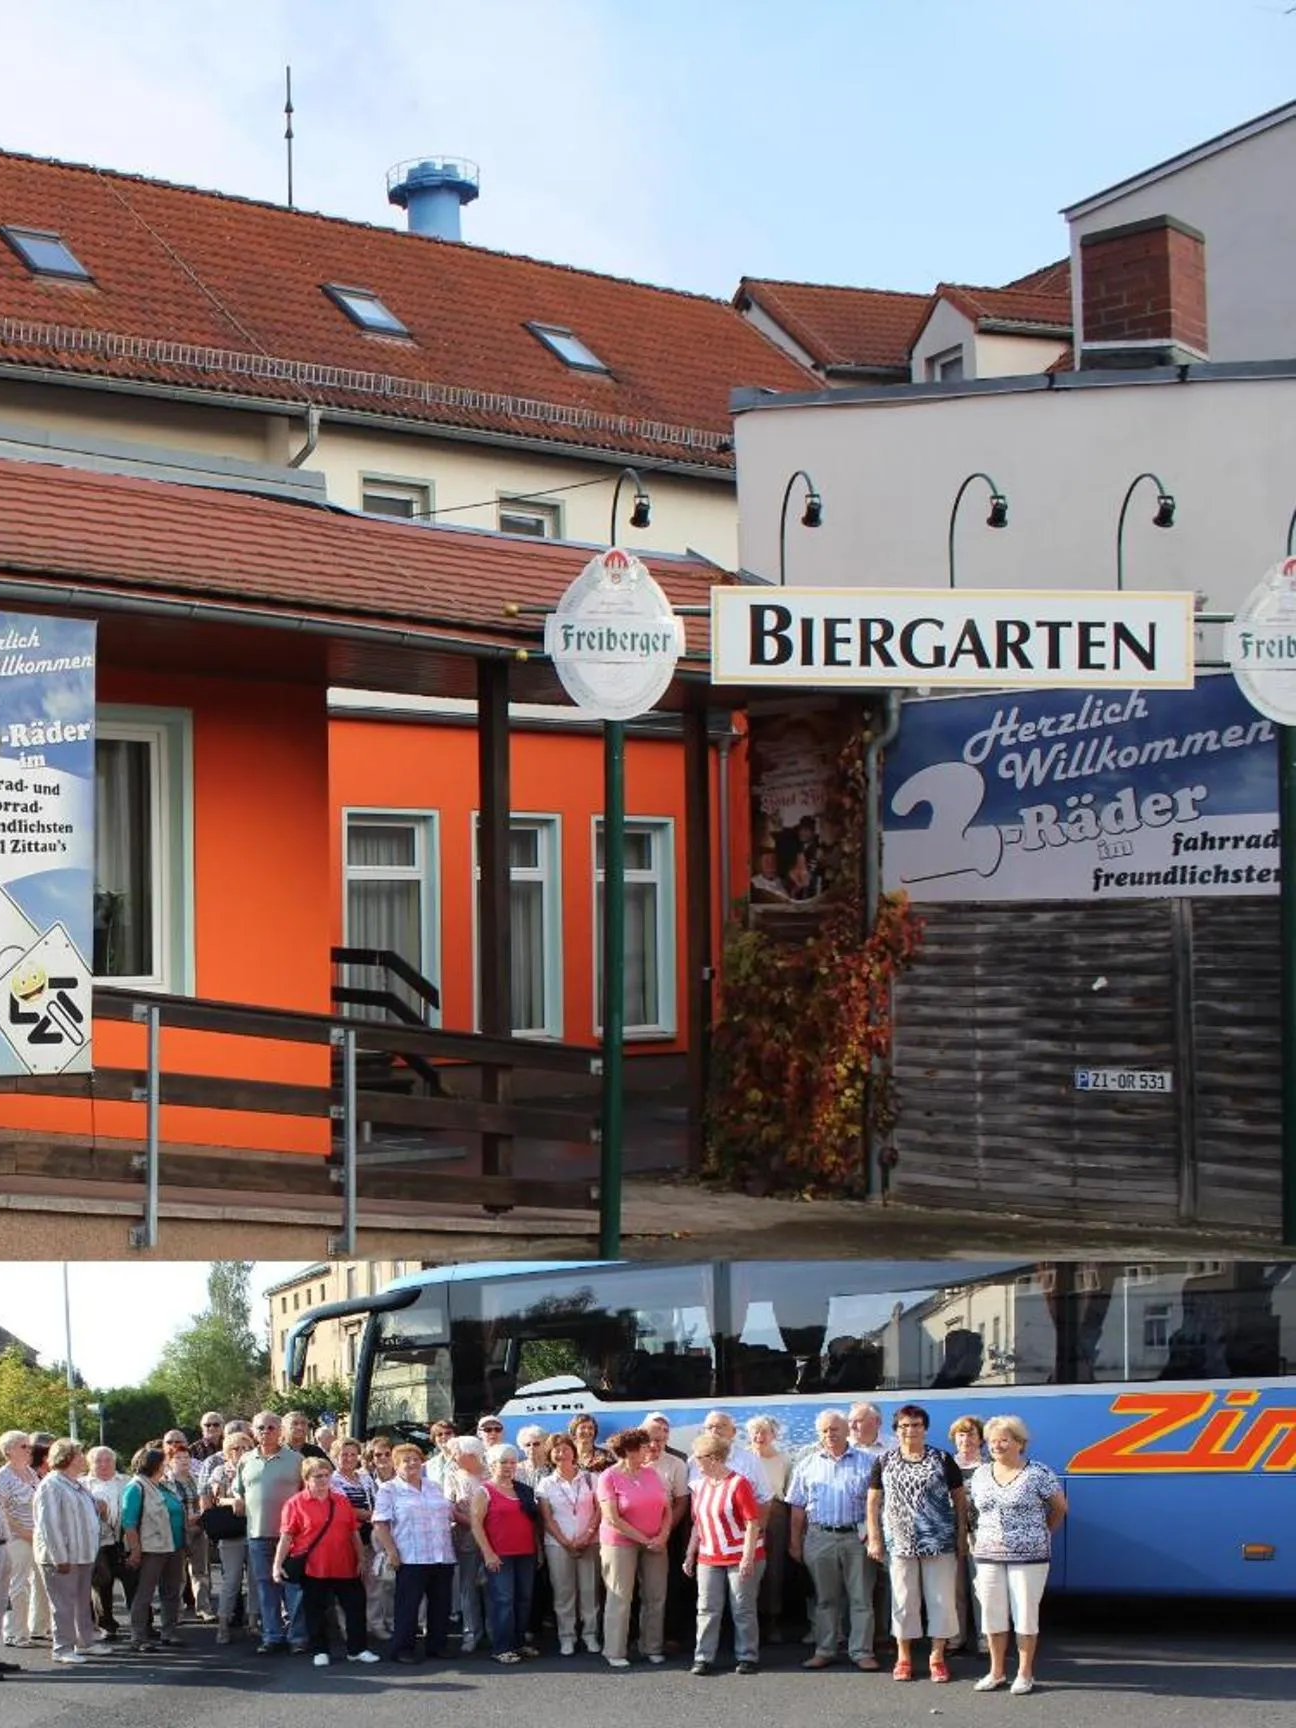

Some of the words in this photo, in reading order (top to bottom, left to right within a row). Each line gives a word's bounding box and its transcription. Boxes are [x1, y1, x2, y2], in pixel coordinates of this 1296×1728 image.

[560, 624, 671, 657] Freiberger
[748, 603, 1157, 671] BIERGARTEN
[963, 689, 1148, 765] Herzlich
[19, 751, 46, 769] im
[998, 719, 1276, 790] Willkommen
[33, 783, 60, 796] und
[10, 839, 66, 853] Zittau's
[1098, 839, 1134, 860] im
[1140, 1074, 1166, 1089] 531
